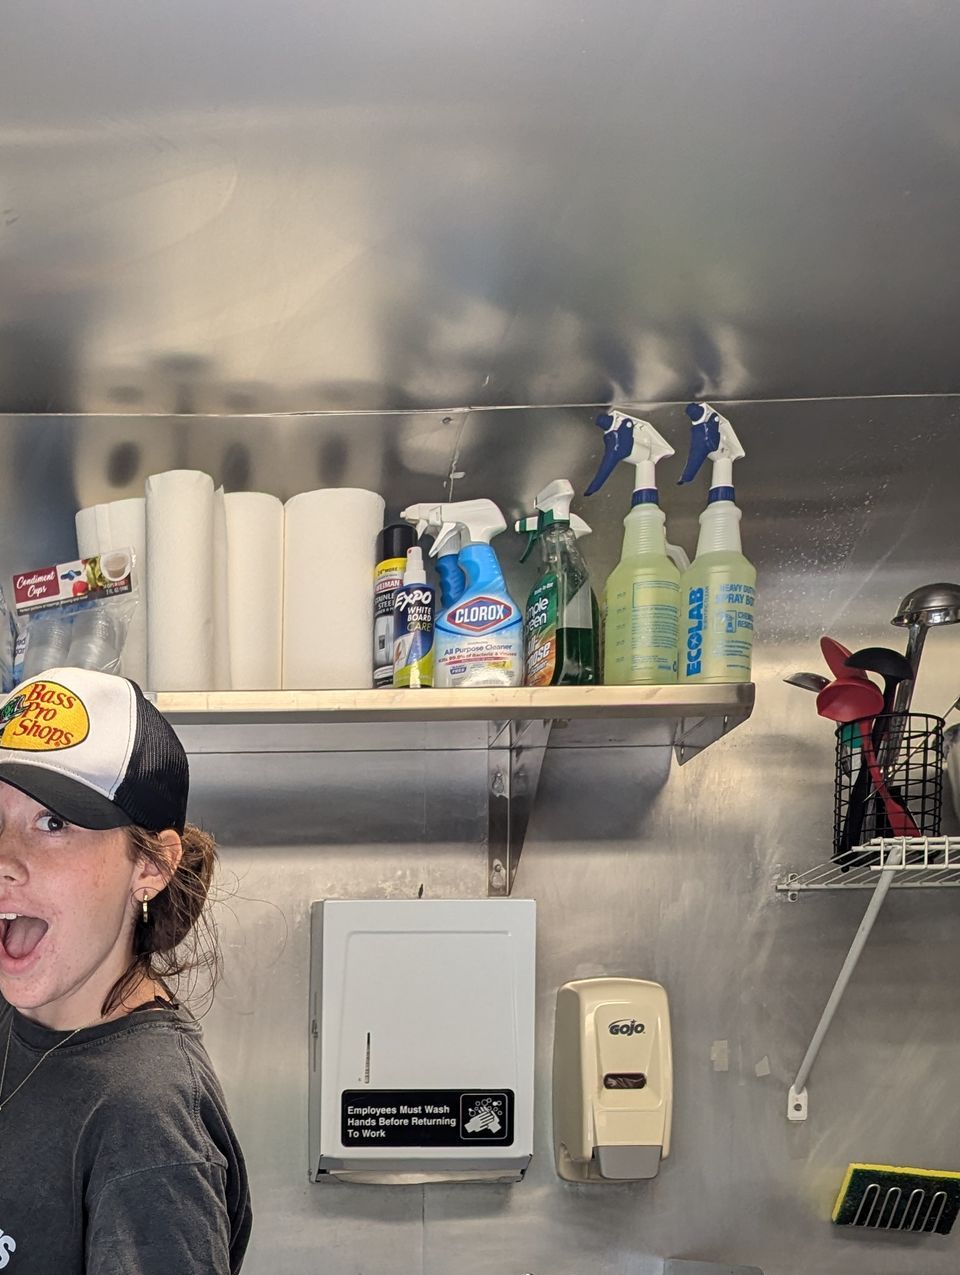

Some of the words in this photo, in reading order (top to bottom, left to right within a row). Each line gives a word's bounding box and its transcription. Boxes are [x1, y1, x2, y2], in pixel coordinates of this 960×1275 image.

[16, 570, 56, 590] Condiment
[27, 585, 48, 598] Cups
[395, 590, 432, 612] EXPO
[407, 606, 432, 615] WHITE
[455, 605, 504, 624] CLOROX
[407, 614, 432, 622] BOARD
[407, 621, 432, 632] CARE
[687, 587, 704, 676] ECOLAB
[444, 648, 453, 656] All
[454, 645, 484, 655] Purpose
[485, 643, 512, 651] Cleaner
[26, 683, 77, 710] Bass
[21, 701, 58, 722] Pro
[13, 718, 74, 747] Shops
[348, 1106, 397, 1117] Employees
[399, 1106, 422, 1114] Must
[425, 1105, 450, 1114] Wash
[348, 1117, 376, 1126] Hands
[379, 1117, 409, 1126] Before
[411, 1117, 457, 1127] Returning
[348, 1130, 359, 1138] To
[362, 1129, 386, 1138] Work
